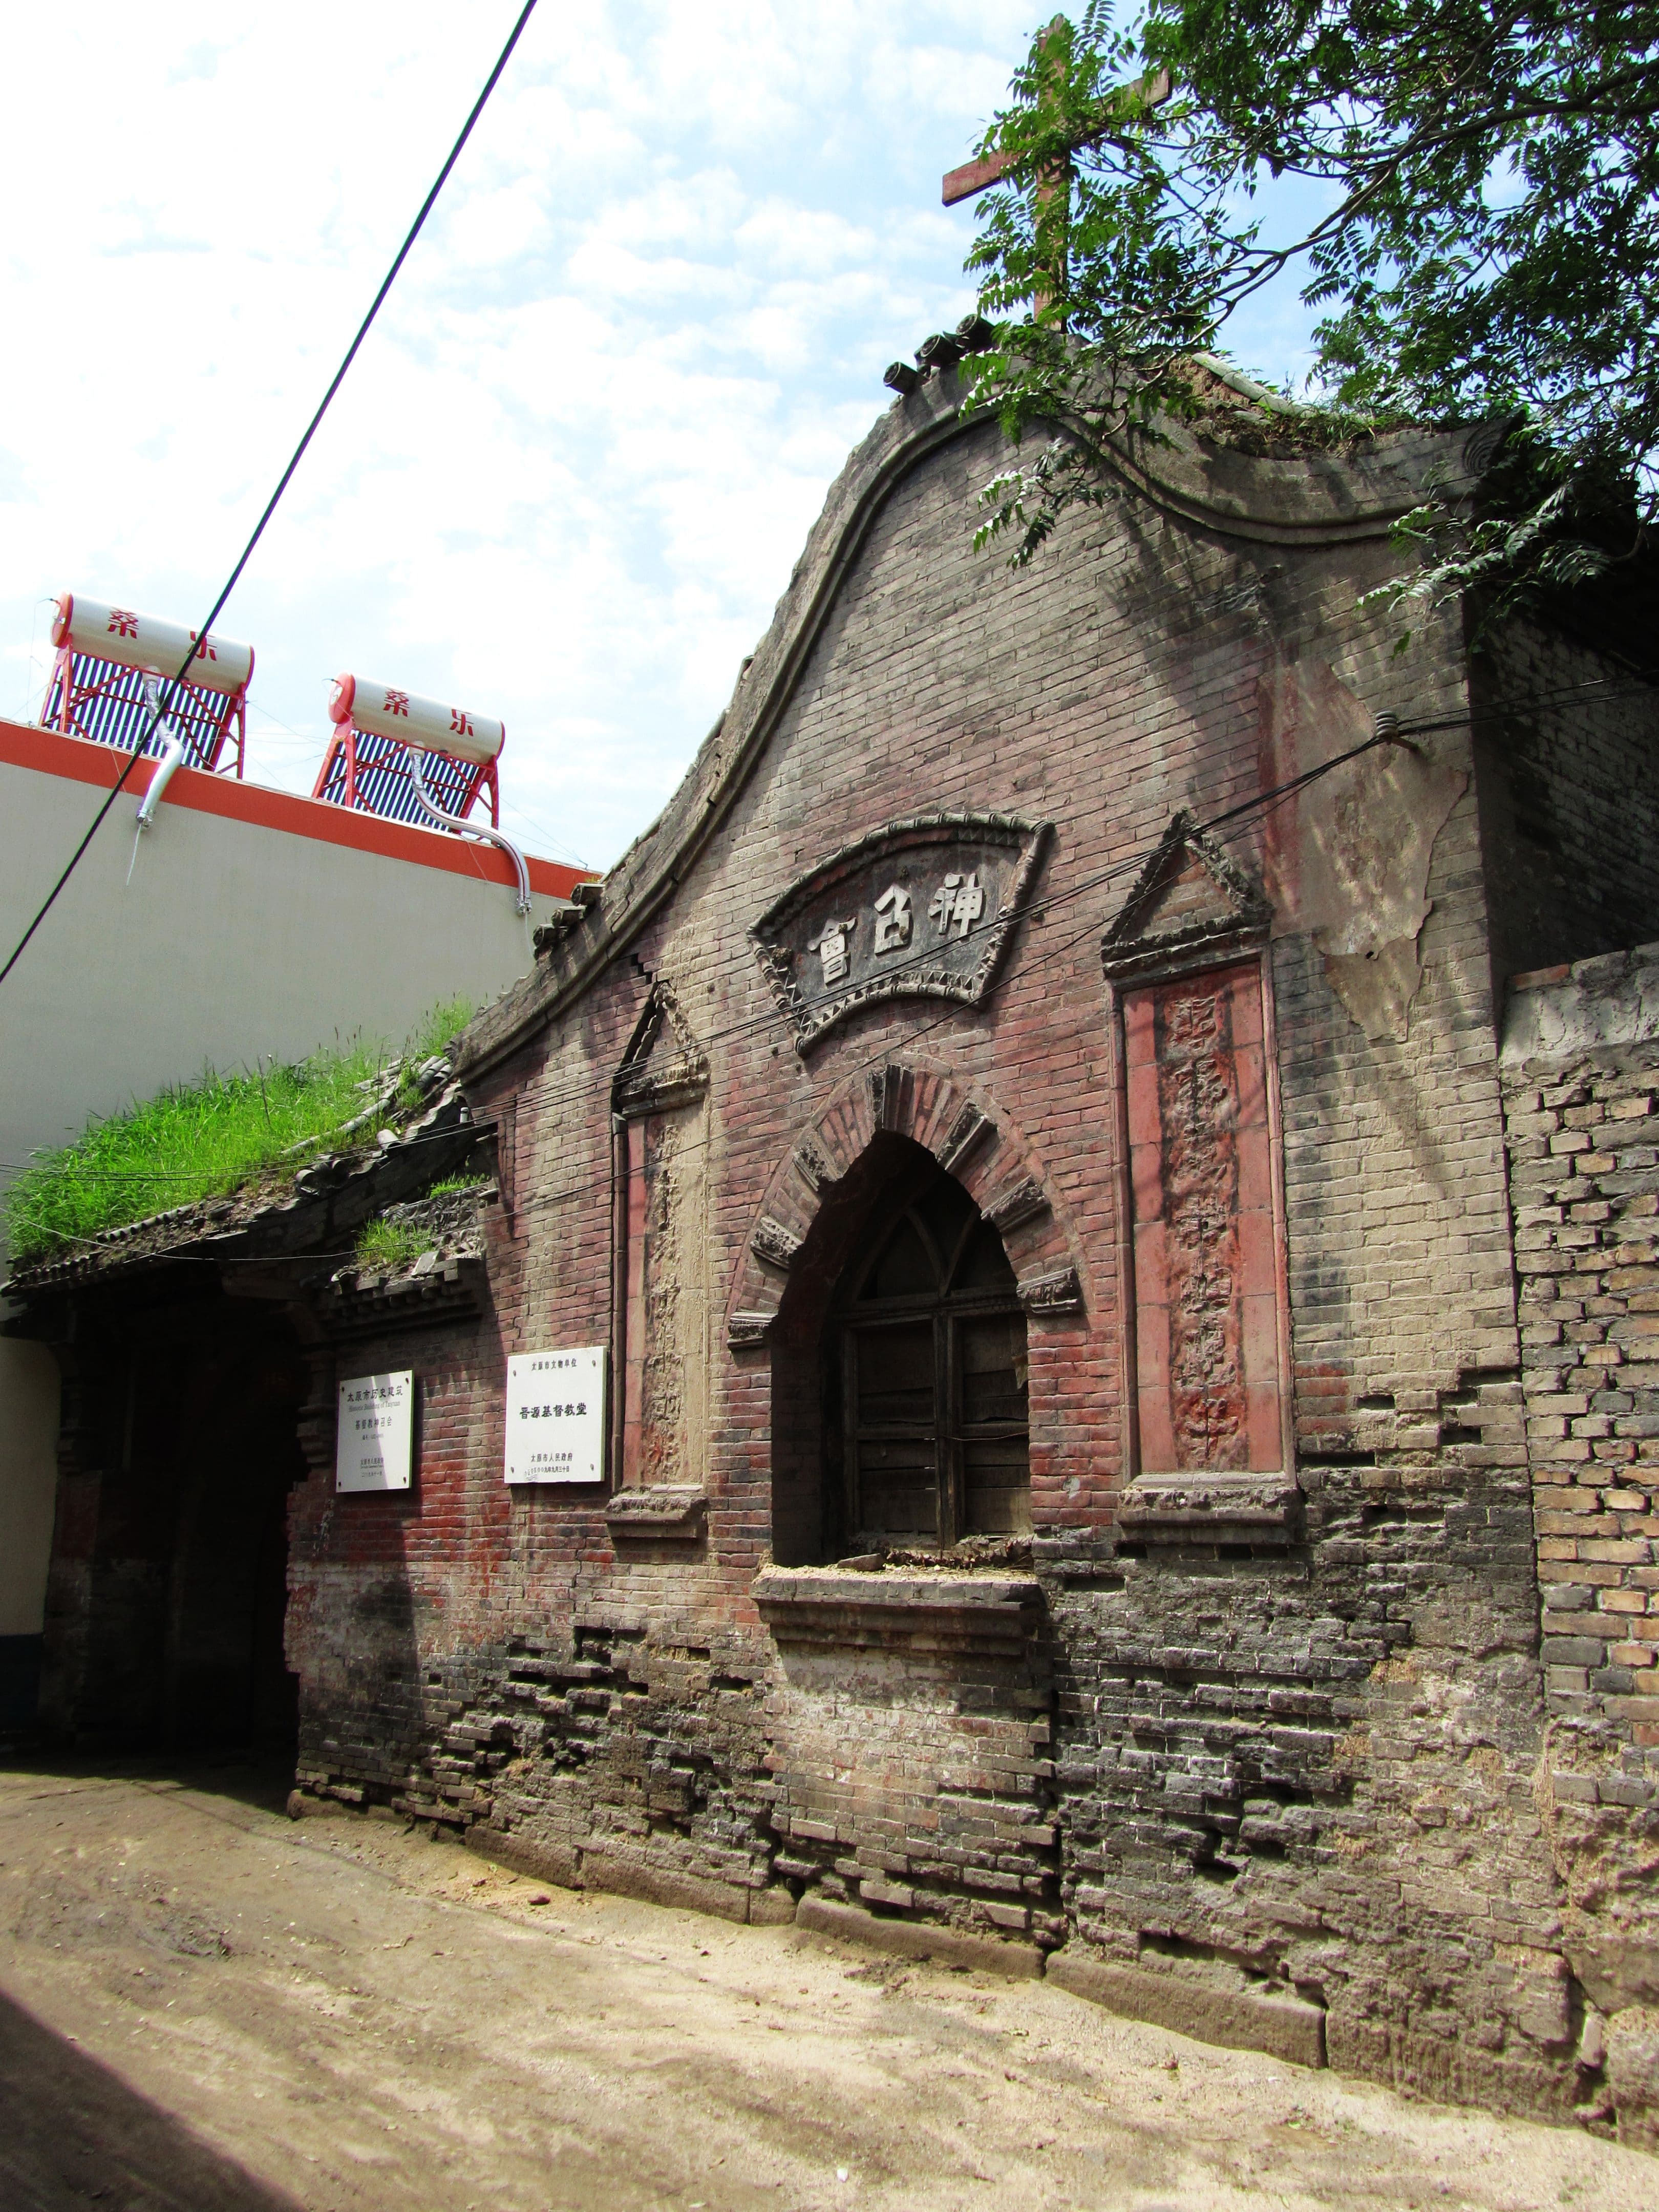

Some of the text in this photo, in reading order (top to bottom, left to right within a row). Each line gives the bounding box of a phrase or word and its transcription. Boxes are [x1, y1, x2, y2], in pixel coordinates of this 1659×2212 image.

[108, 607, 217, 662] 桑乐
[383, 686, 474, 737] 桑乐
[531, 1358, 577, 1371] 太原市文物单位
[347, 1386, 403, 1402] 太原市历史建筑
[519, 1402, 587, 1419] 晋源基督教堂
[531, 1453, 573, 1463] 太原市人民政府
